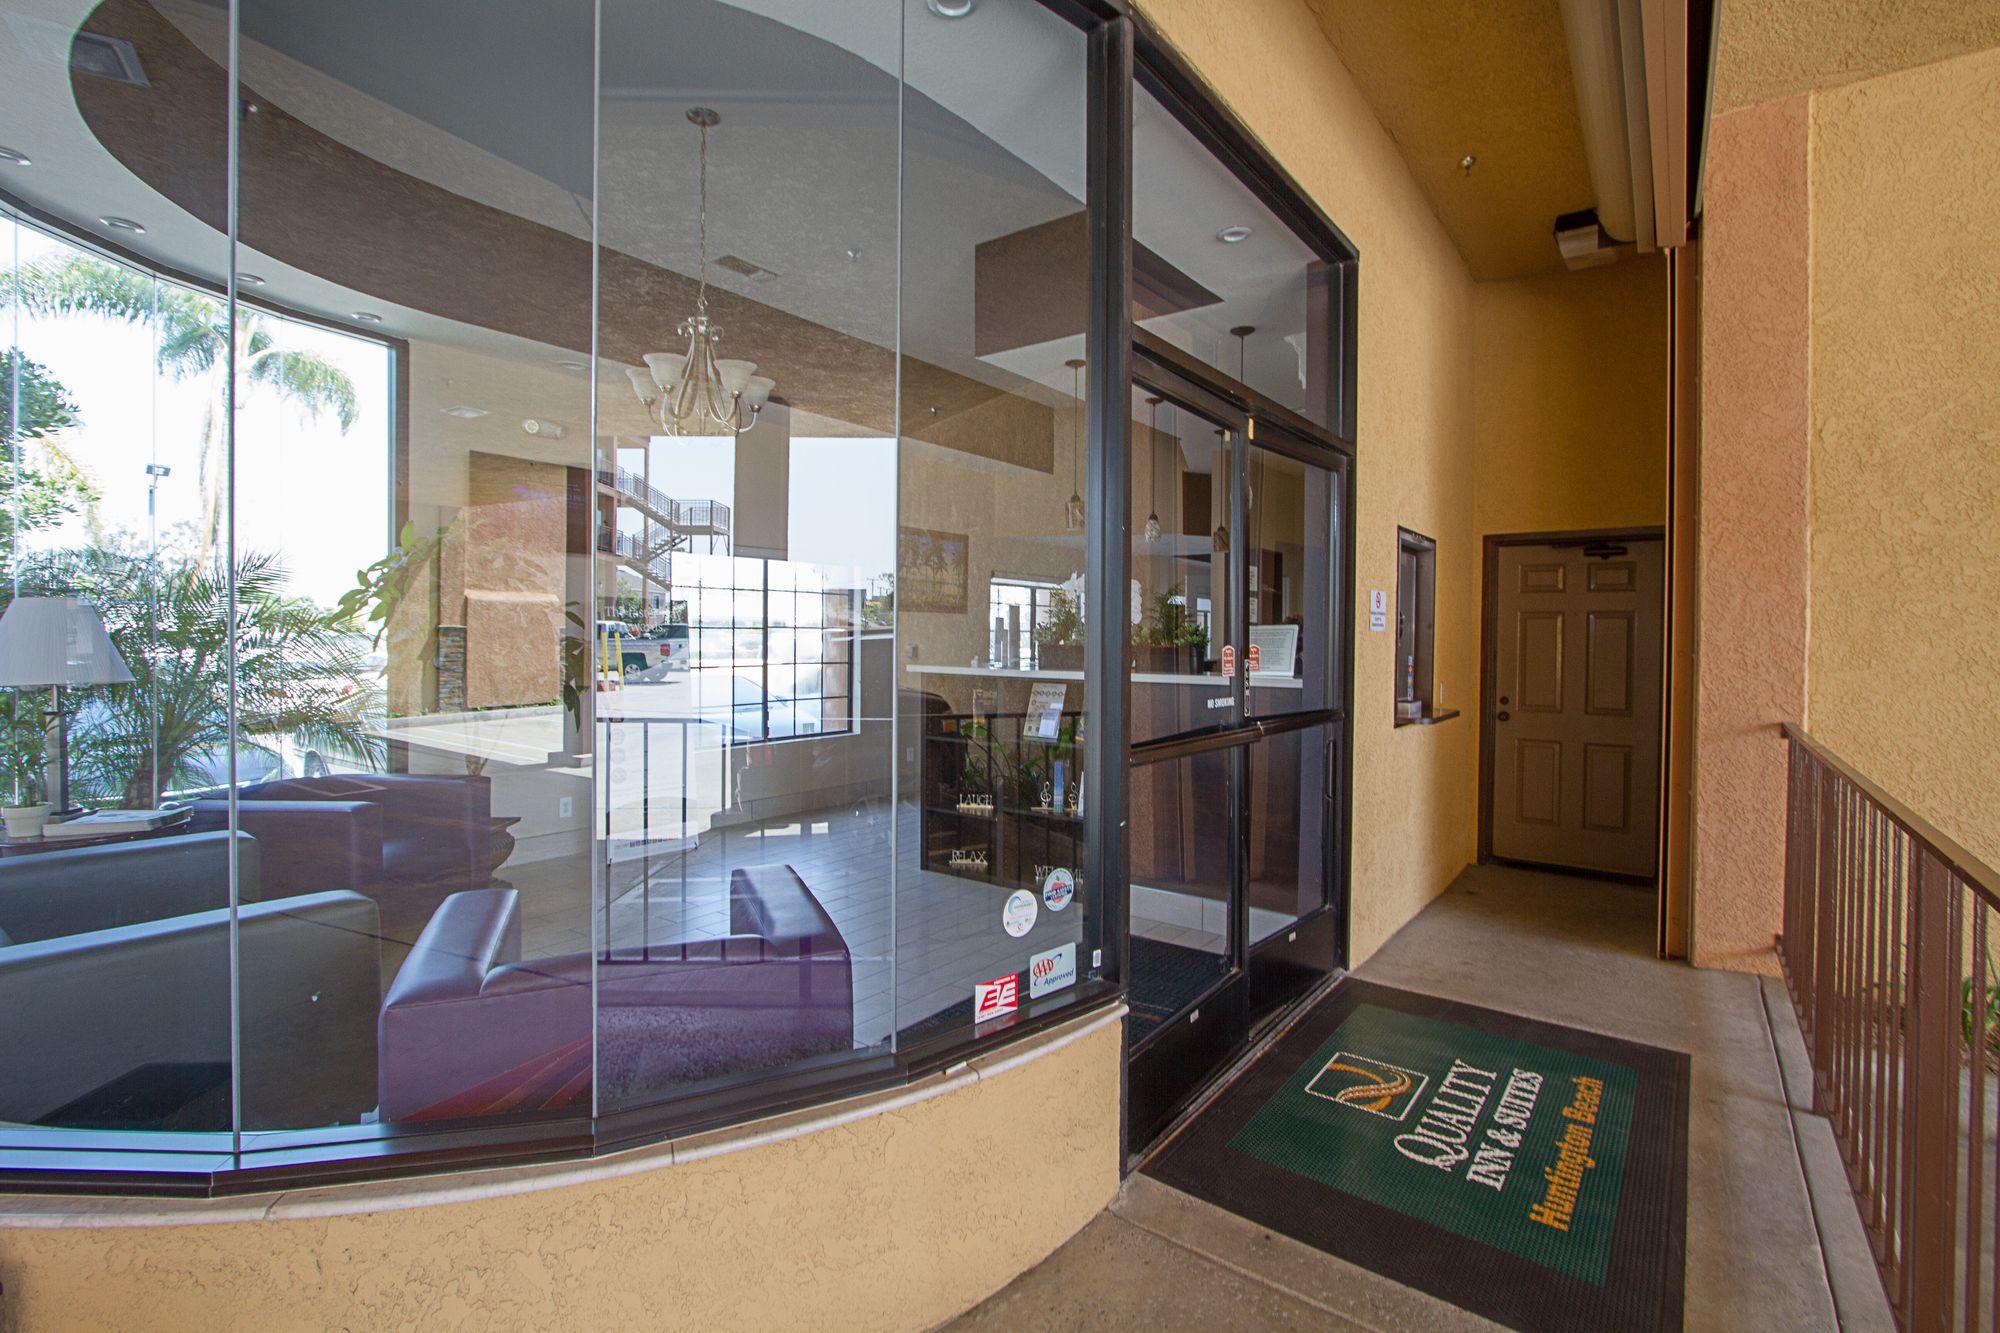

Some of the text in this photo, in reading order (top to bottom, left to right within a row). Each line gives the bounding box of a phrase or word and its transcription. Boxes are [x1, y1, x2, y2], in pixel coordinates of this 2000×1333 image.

[1208, 696, 1235, 709] NO SMOKING
[959, 793, 992, 806] LAUGH
[951, 850, 987, 864] RELAX
[1034, 864, 1084, 882] WEME
[1033, 958, 1054, 978] AAA
[1043, 967, 1075, 986] Approved
[1394, 1058, 1498, 1171] QUALITY
[1465, 1067, 1544, 1192] INN & SUITES
[1529, 1076, 1604, 1232] Huntington Beach
